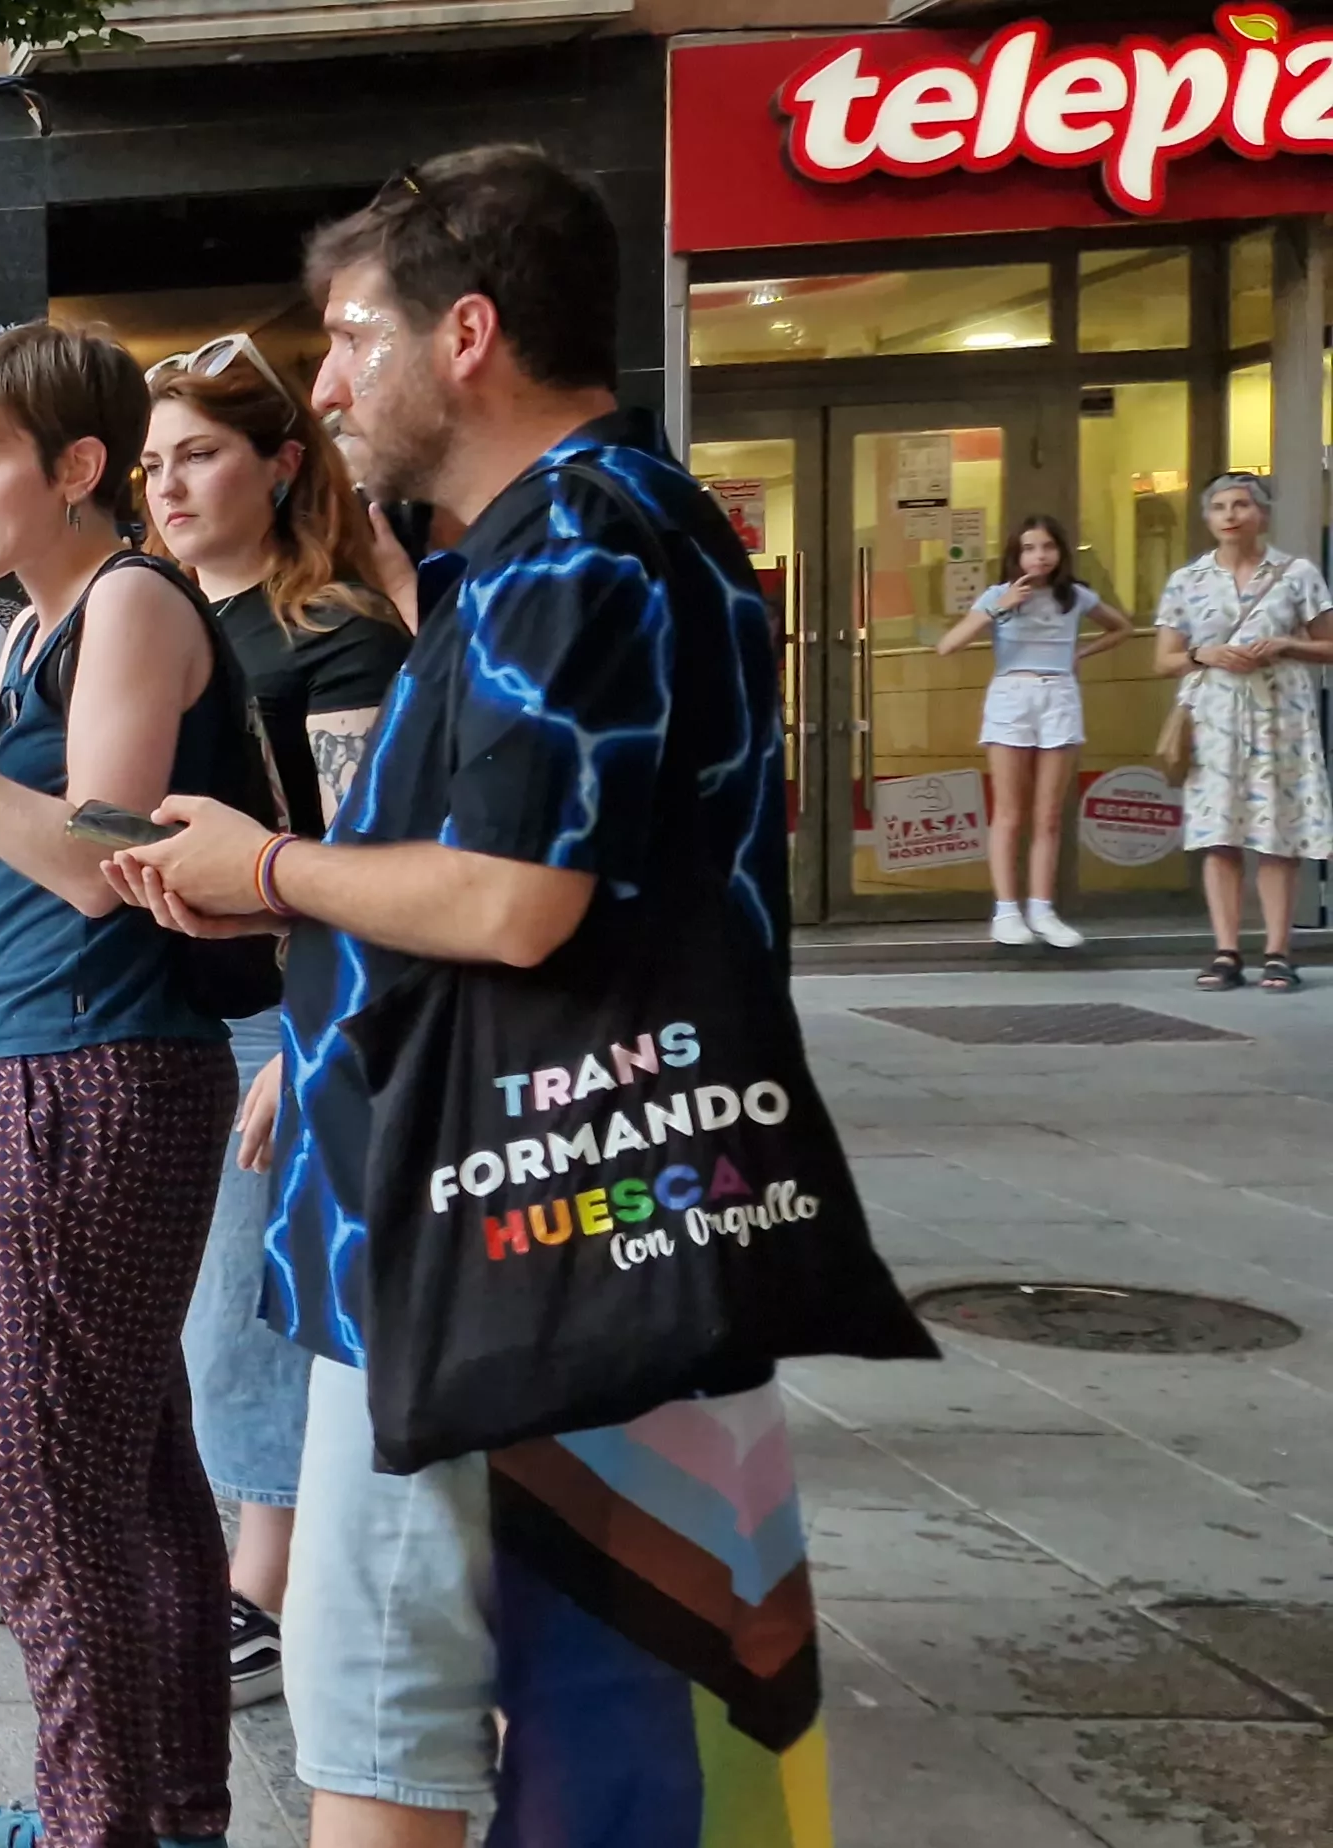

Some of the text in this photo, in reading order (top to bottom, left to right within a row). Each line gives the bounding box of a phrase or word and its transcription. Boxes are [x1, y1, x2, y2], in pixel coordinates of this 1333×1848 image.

[493, 1021, 701, 1118] TRANS
[429, 1080, 790, 1214] FORMANDO
[483, 1154, 753, 1262] HUESCA
[685, 1180, 820, 1248] Orgullo
